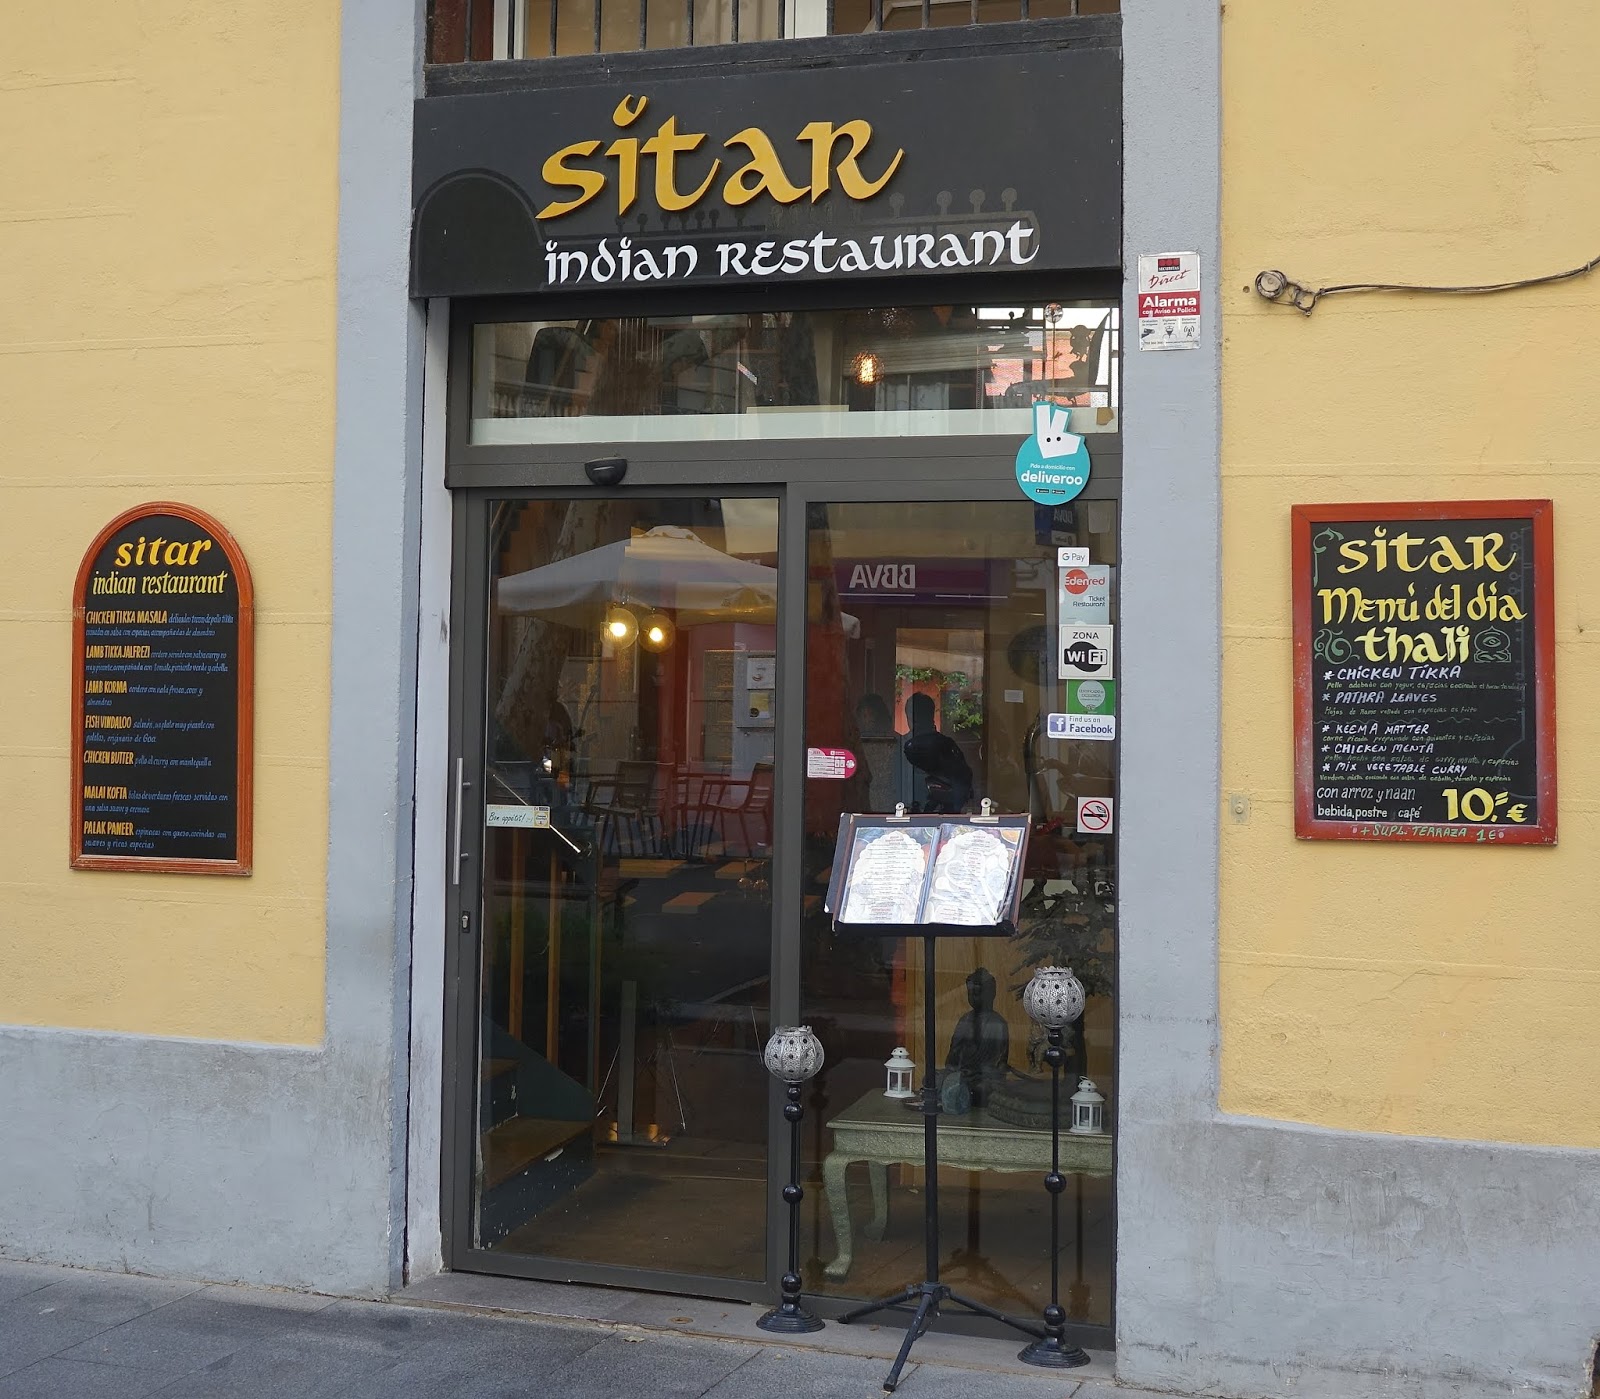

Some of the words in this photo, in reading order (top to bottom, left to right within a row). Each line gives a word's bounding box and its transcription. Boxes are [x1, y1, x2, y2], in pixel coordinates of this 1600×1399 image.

[545, 235, 698, 285] indian
[1149, 269, 1191, 289] Direct
[1142, 295, 1197, 308] Alarma
[1021, 470, 1083, 485] deliveroo
[114, 536, 212, 567] sitar
[1071, 553, 1086, 562] Pay
[92, 570, 137, 595] indian
[141, 570, 228, 595] restaurant
[1065, 576, 1106, 586] Edenred
[1425, 583, 1461, 622] del
[86, 611, 116, 624] CHICKEN
[116, 610, 136, 624] TIKKA
[137, 610, 168, 624] MASALA
[1072, 631, 1099, 640] ZONA
[1354, 624, 1470, 664] thali
[86, 645, 104, 659] LAMB
[85, 680, 104, 694] LAMB
[104, 681, 127, 694] KORMA
[1390, 692, 1438, 703] LEAVES
[85, 715, 99, 729] FISH
[99, 716, 132, 729] VINDALOO
[1069, 724, 1113, 734] Facebook
[1385, 724, 1430, 735] MATTER
[1334, 743, 1388, 755] CHICKEN
[1391, 743, 1434, 754] MENTA
[84, 750, 110, 765] CHICKEN
[110, 751, 135, 765] BUTTER
[1367, 763, 1427, 774] VEGETABLE
[1432, 765, 1468, 778] CURRY
[84, 785, 106, 800] MALAI
[106, 786, 127, 801] KOFTA
[1316, 787, 1339, 799] con
[1341, 787, 1374, 800] arroz
[1385, 788, 1416, 801] naan
[1398, 806, 1422, 822] café
[83, 821, 107, 835] PALAK
[107, 822, 134, 837] PANEER
[1412, 826, 1468, 838] TERRAZA
